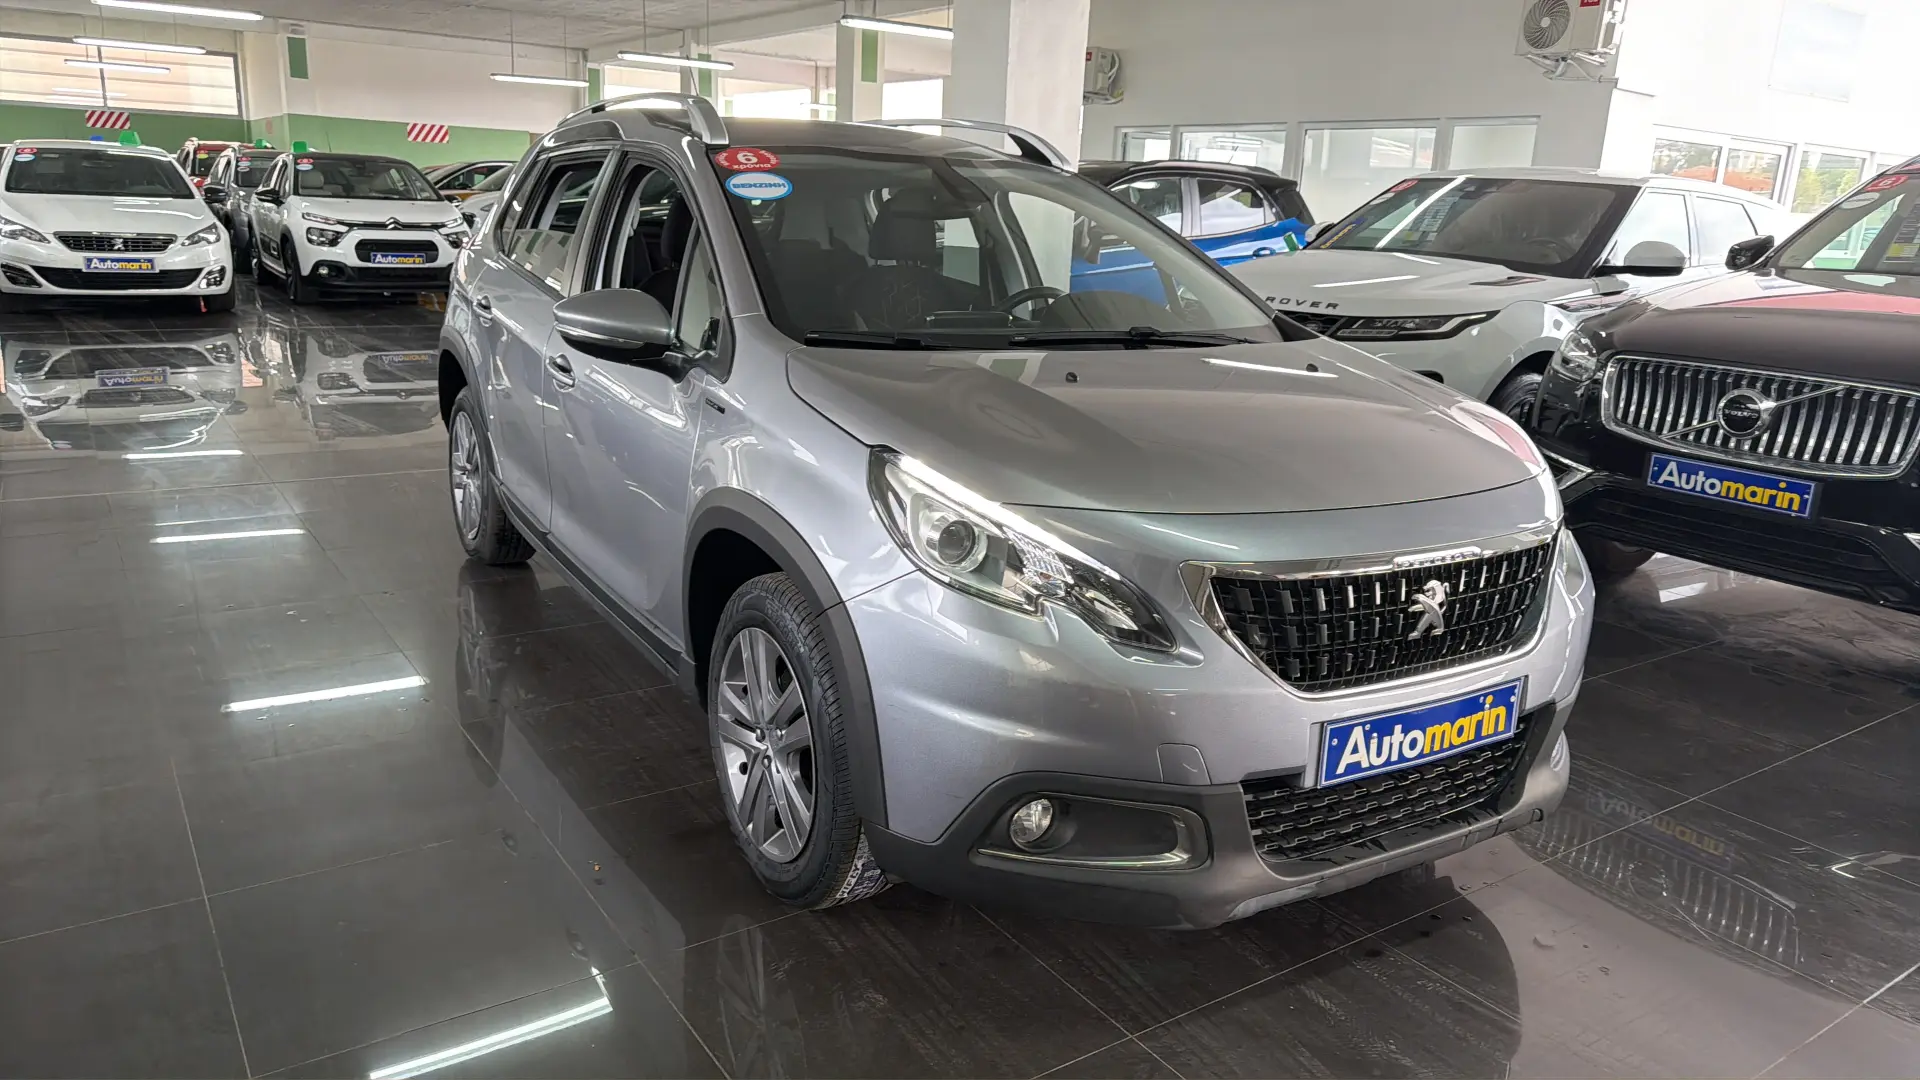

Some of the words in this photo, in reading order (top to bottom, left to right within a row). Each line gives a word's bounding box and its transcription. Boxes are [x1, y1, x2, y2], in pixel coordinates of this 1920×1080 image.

[736, 152, 759, 164] 6
[90, 258, 152, 270] Automarin
[374, 253, 423, 264] Automarin
[1265, 296, 1339, 310] ROVER
[1657, 461, 1801, 511] Automarin
[1336, 694, 1507, 775] Automarin
